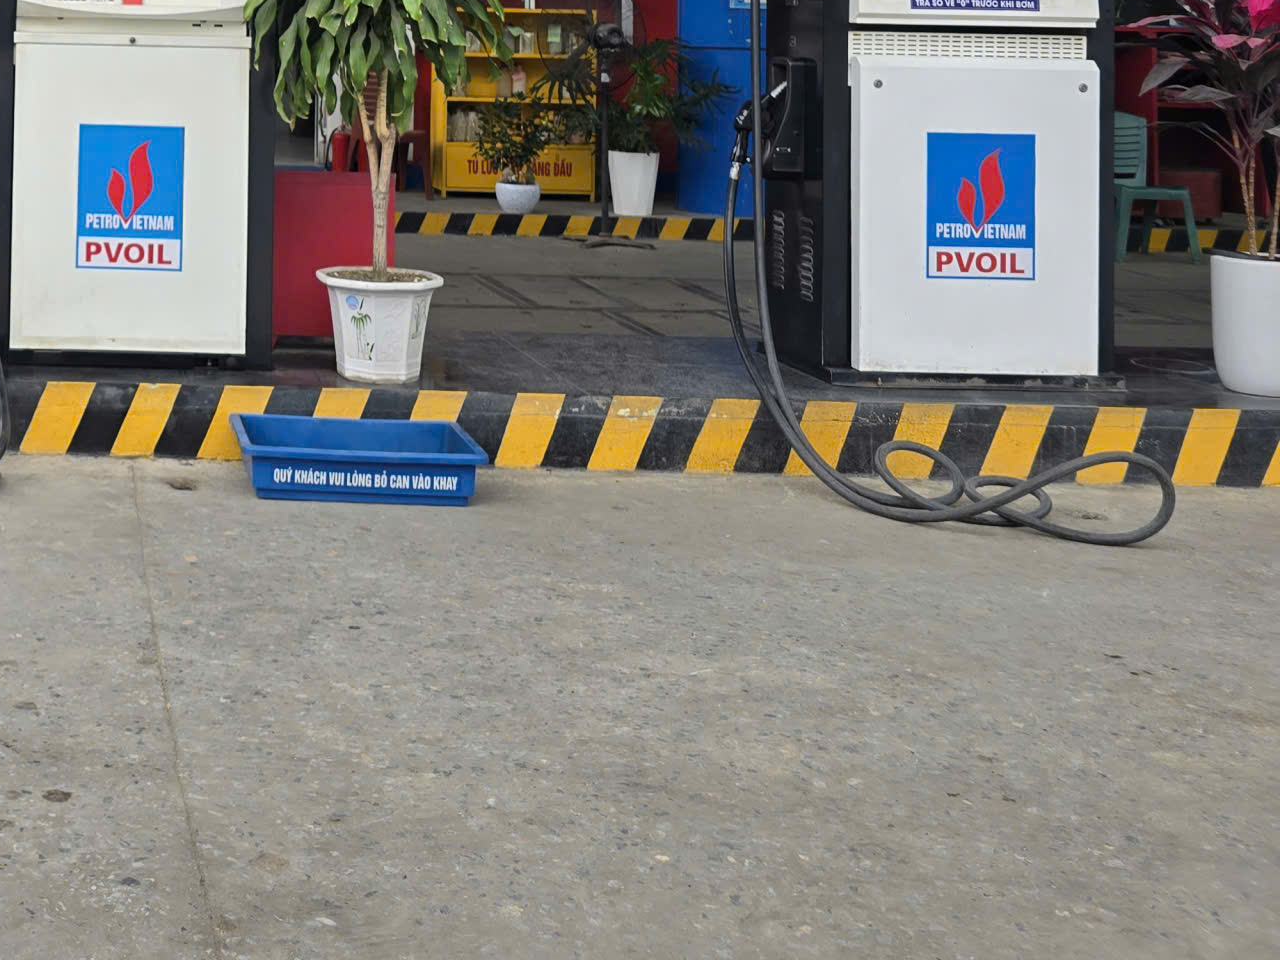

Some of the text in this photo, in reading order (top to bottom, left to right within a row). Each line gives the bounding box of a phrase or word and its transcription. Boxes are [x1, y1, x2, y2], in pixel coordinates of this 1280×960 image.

[1000, 0, 1014, 8] KHI
[1016, 0, 1035, 9] BƠM
[85, 213, 174, 231] PETROVIETNAM
[935, 223, 1026, 239] PETROVIETNAM
[85, 242, 172, 265] PVOIL
[936, 251, 1024, 273] PVOIL
[273, 466, 458, 491] QUÝ KHÁCH VUI LÒNG BỎ CAN VÀO KHAY
